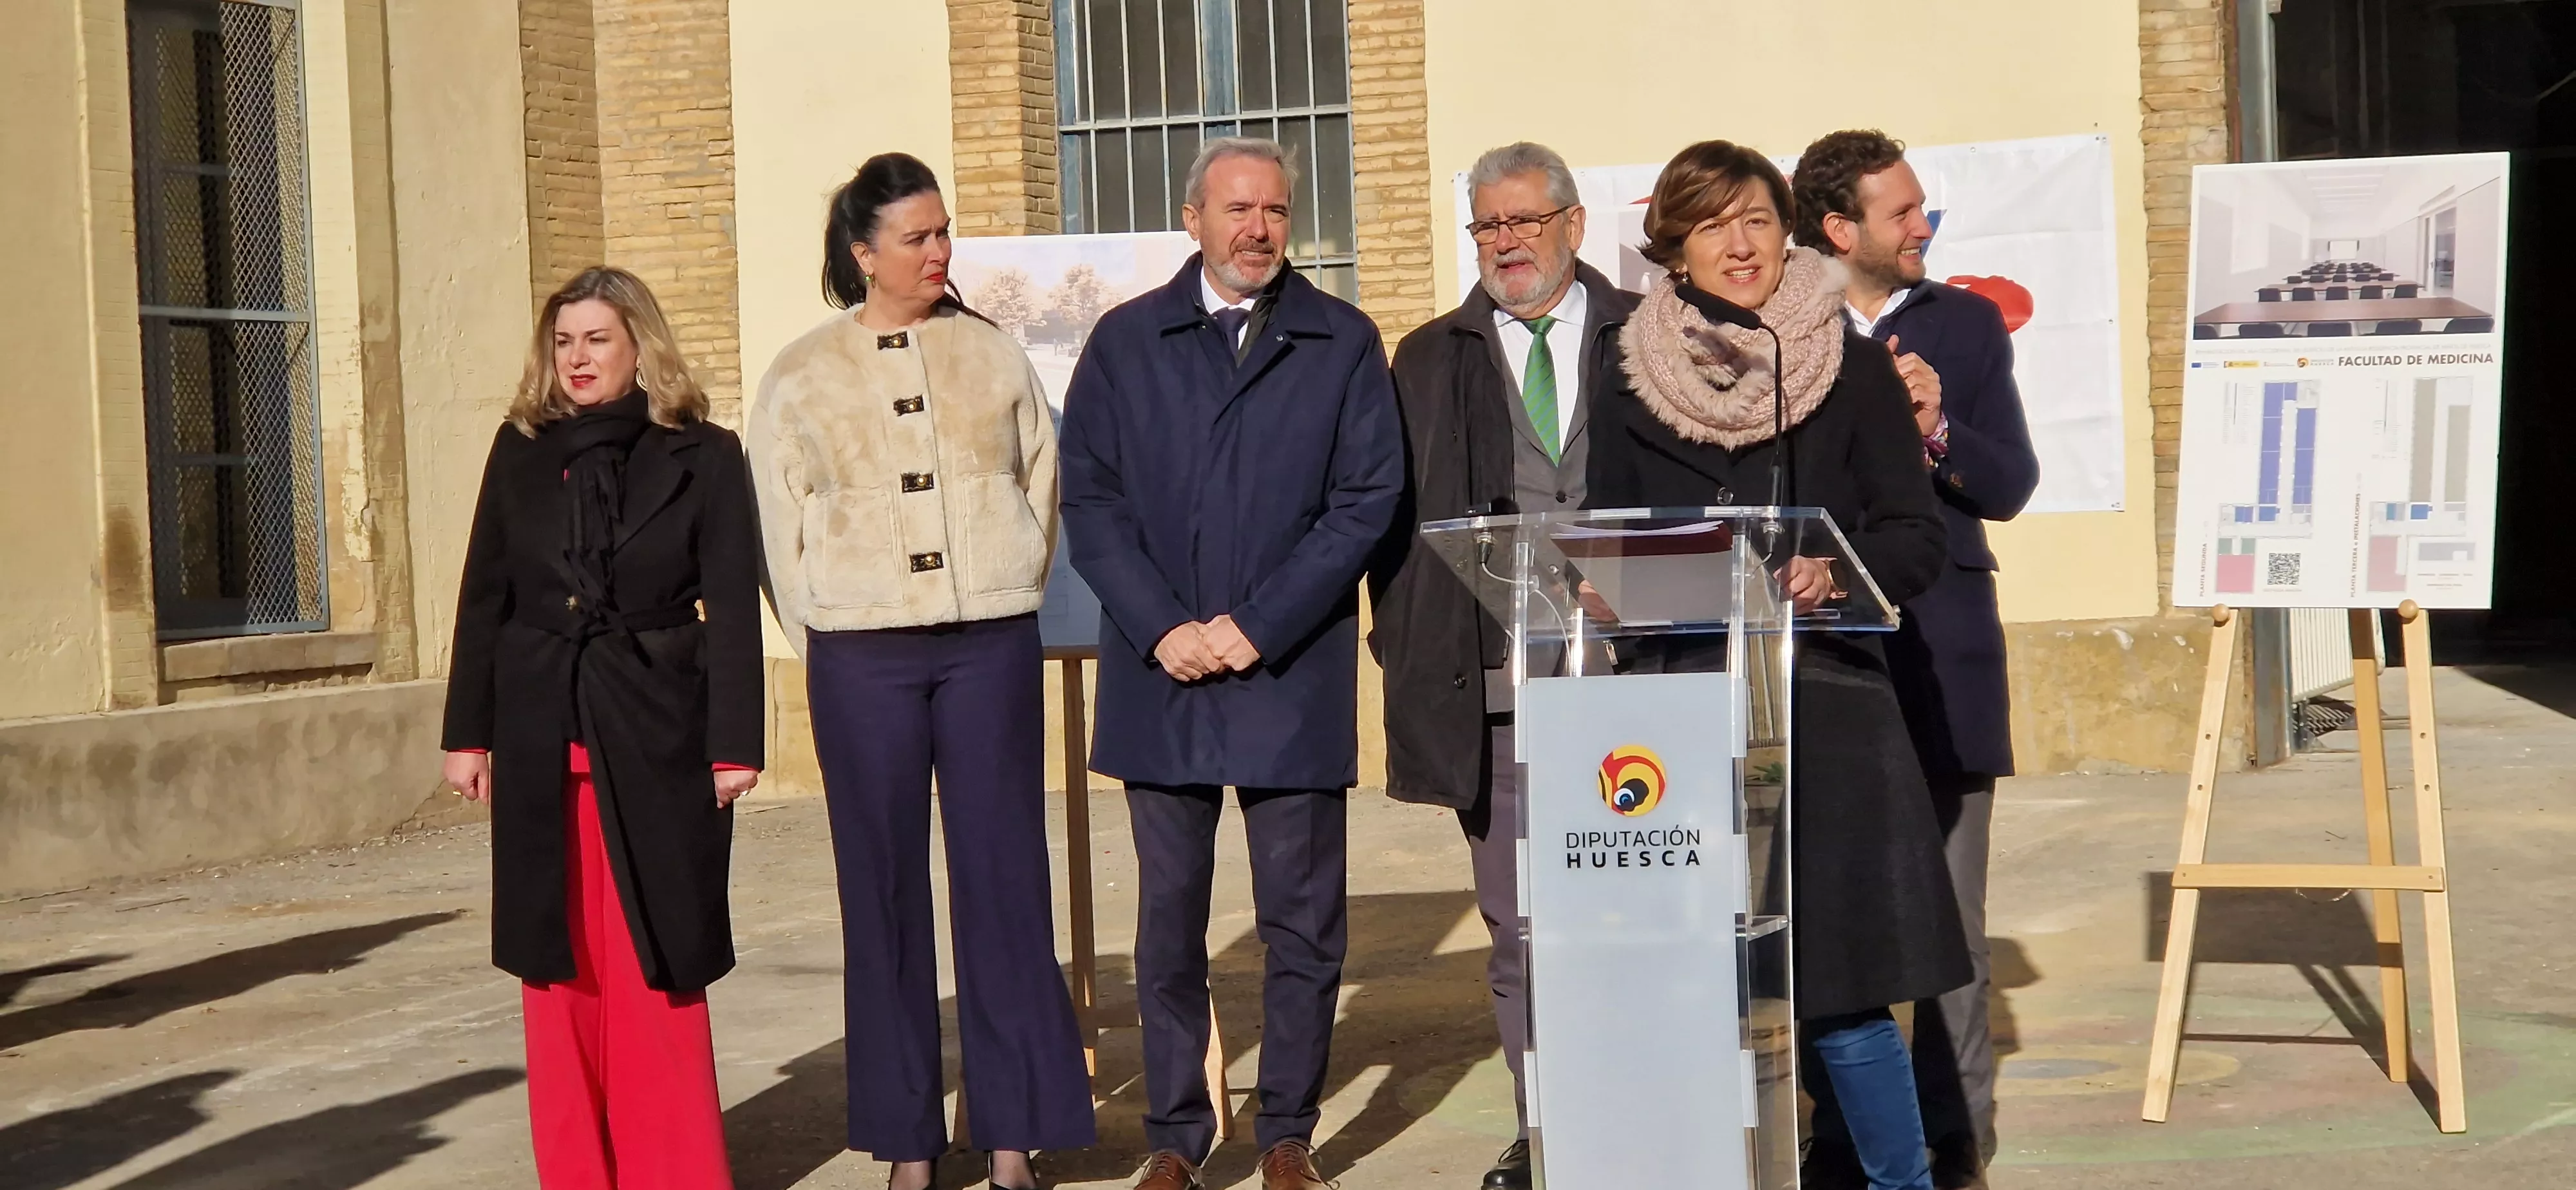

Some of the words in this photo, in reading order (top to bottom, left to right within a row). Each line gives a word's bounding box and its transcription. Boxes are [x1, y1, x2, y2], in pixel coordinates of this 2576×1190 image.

[2338, 355, 2403, 366] FACULTAD
[2407, 354, 2423, 365] DE
[2427, 353, 2494, 364] MEDICINA
[1566, 824, 1701, 849] DIPUTACIÓN
[1566, 849, 1701, 869] HUESCA
